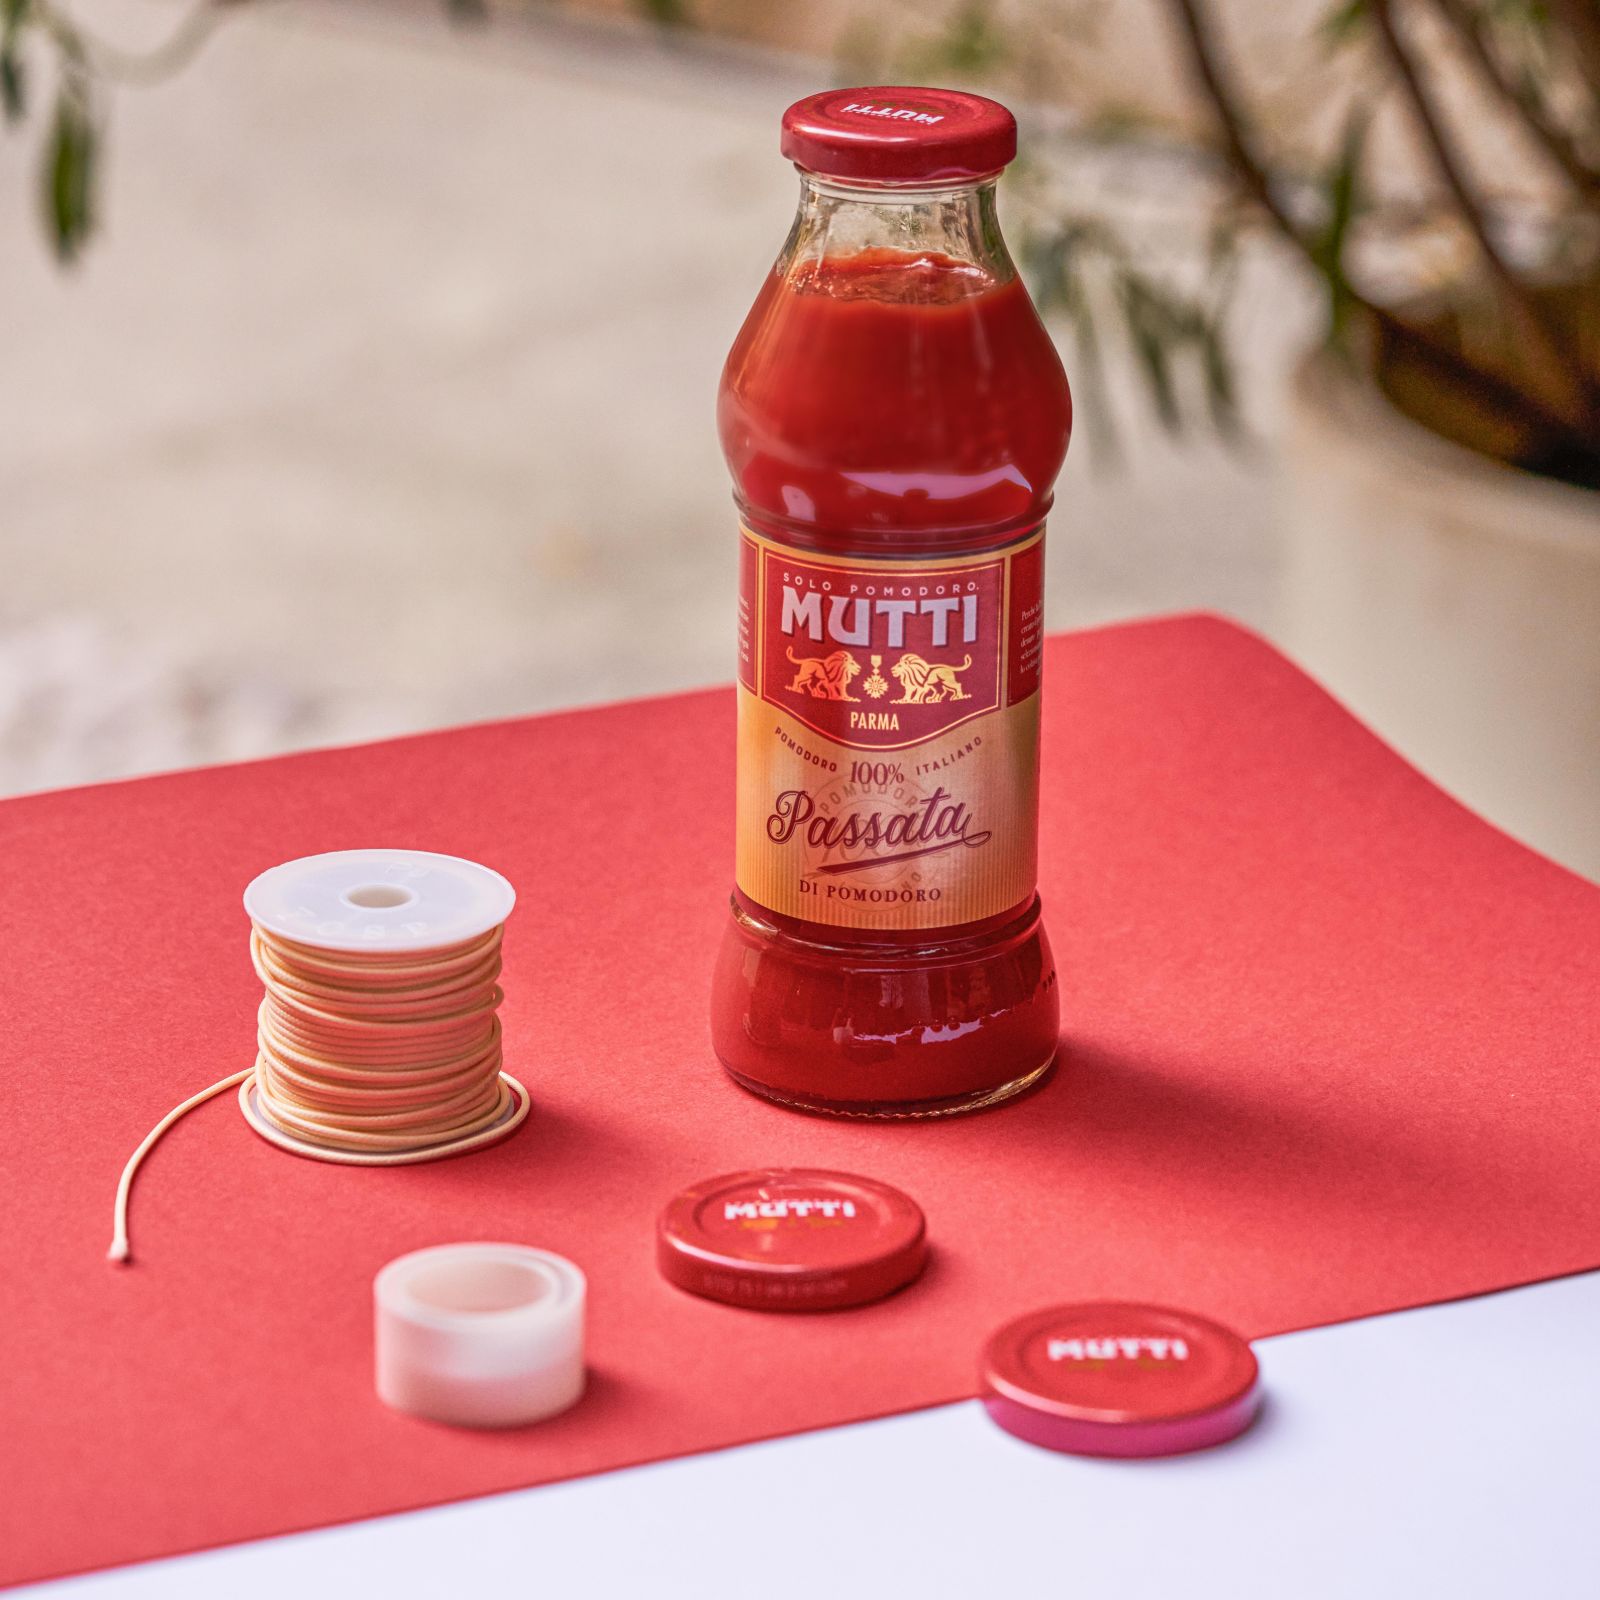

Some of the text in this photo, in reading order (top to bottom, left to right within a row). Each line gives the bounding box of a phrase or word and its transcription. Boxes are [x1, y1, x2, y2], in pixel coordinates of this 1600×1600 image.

[840, 103, 945, 124] MUTTI
[783, 571, 832, 592] SOLO
[781, 585, 977, 648] MUTTI
[850, 712, 900, 732] PARMA
[774, 726, 838, 773] POMODORO
[915, 736, 982, 776] ITALIANO
[849, 760, 905, 786] 100%
[766, 786, 993, 849] Passata
[799, 879, 942, 903] DI POMODORO
[724, 1199, 856, 1220] MUTTI
[1047, 1337, 1190, 1361] MUTTI
